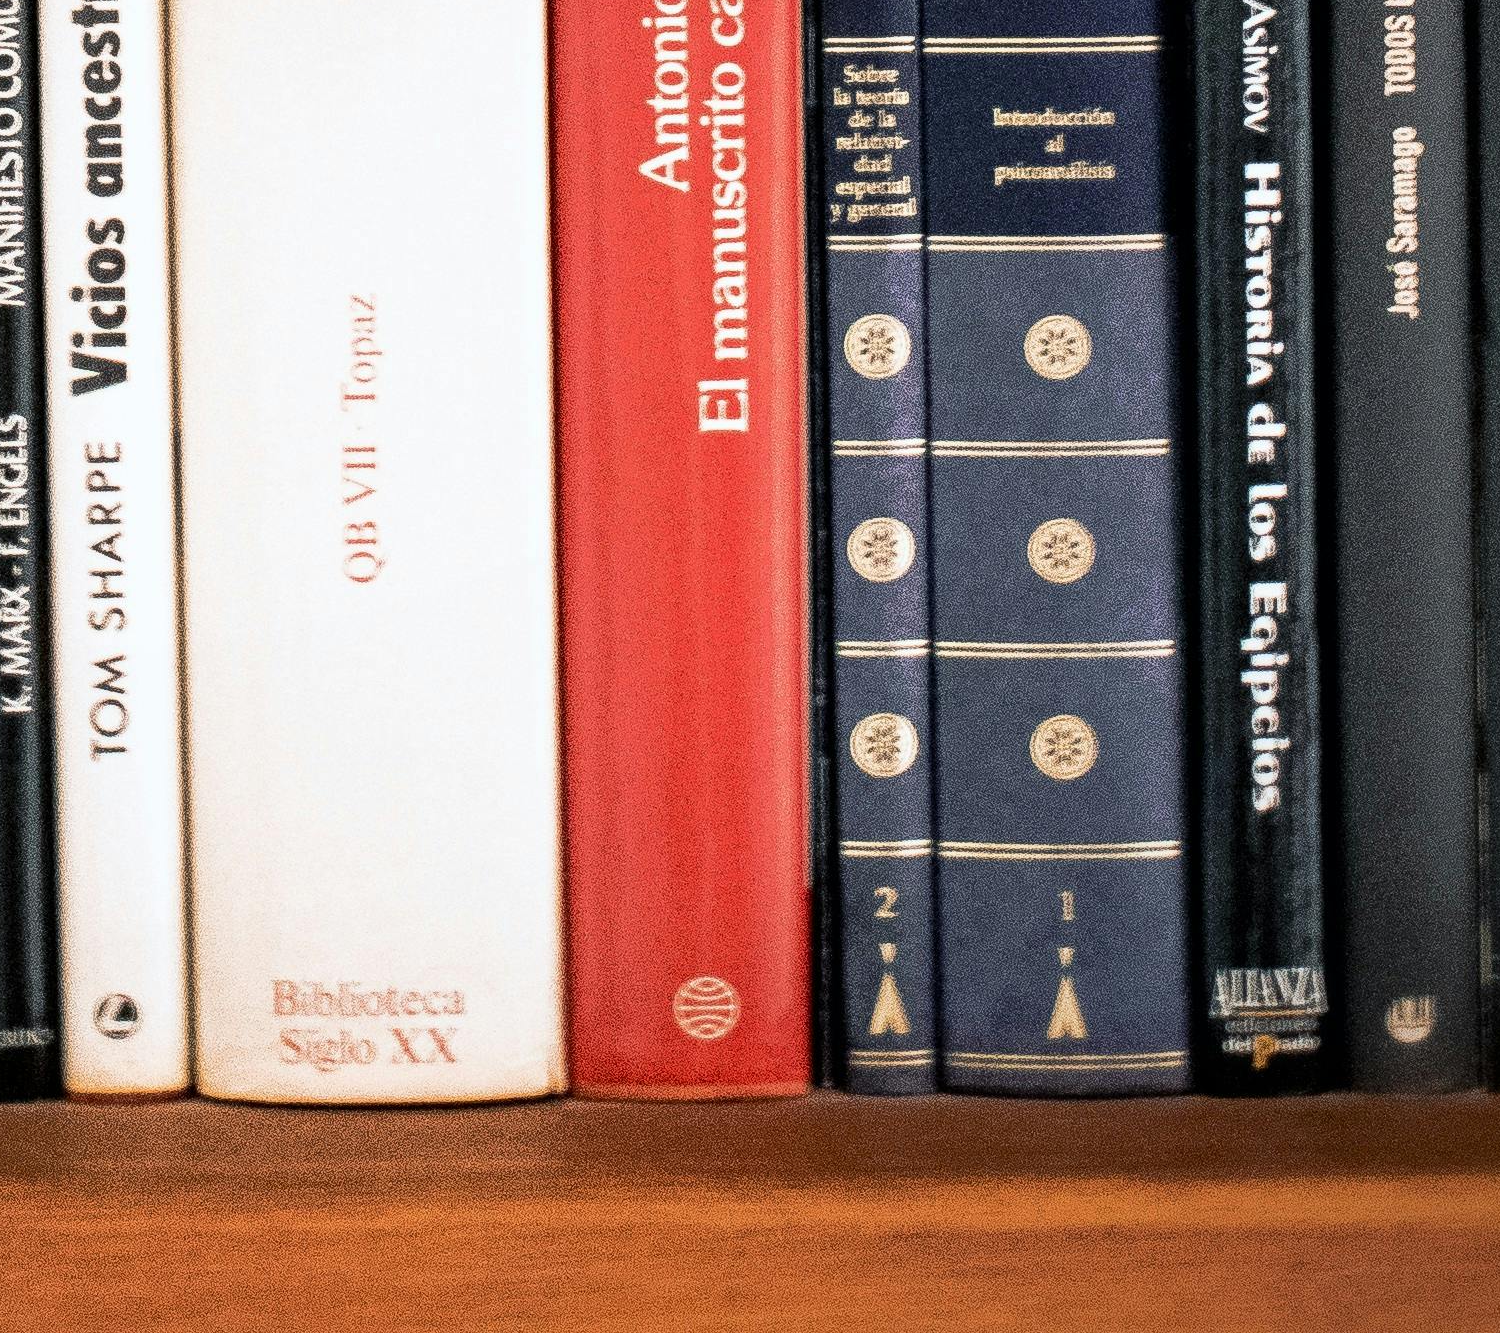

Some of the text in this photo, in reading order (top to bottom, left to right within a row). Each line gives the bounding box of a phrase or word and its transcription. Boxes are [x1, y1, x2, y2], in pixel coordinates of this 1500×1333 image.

[1384, 15, 1416, 96] TODOS
[699, 62, 748, 360] manuscrito
[1386, 126, 1424, 253] Saramago
[70, 218, 127, 396] Vicios
[1388, 261, 1419, 319] José
[341, 295, 384, 584] QB VII Topaz
[698, 378, 749, 432] El
[85, 445, 125, 631] SHARPE
[0, 585, 32, 676] MARX
[1, 685, 33, 713] K.
[90, 655, 127, 759] TOM
[874, 886, 898, 918] 2
[1059, 891, 1075, 921] 1
[269, 979, 465, 1019] Biblioteca
[276, 1028, 456, 1074] Siglo XX
